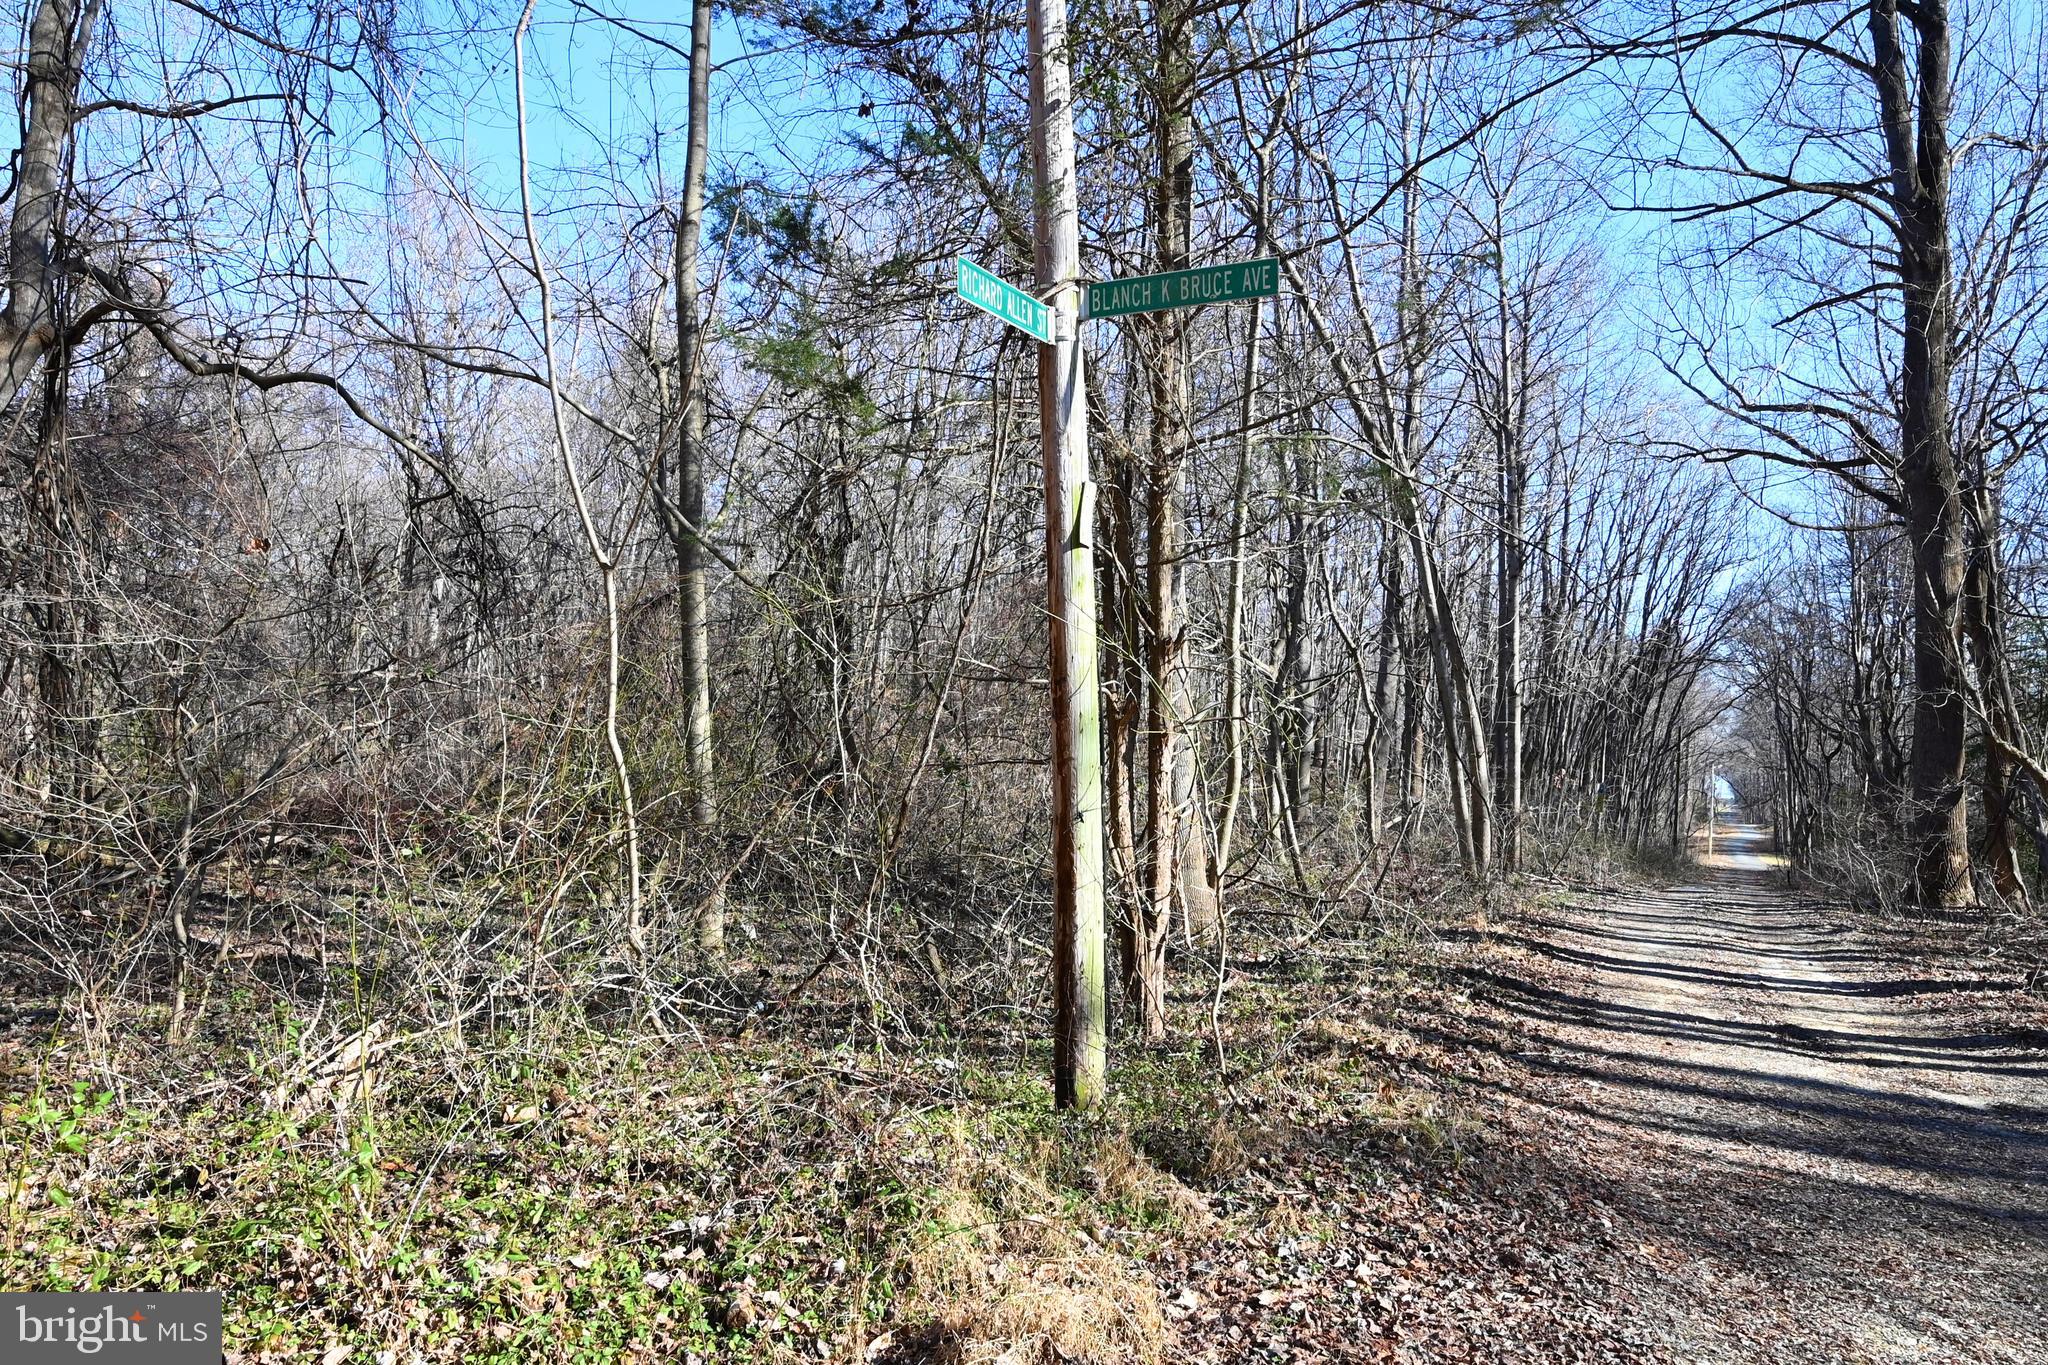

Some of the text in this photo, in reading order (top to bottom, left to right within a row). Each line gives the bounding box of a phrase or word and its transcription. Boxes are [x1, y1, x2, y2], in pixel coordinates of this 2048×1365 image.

[961, 265, 1047, 332] RICHARD ALLEN ST
[1092, 265, 1271, 312] BLANCH K BRUCE AVE
